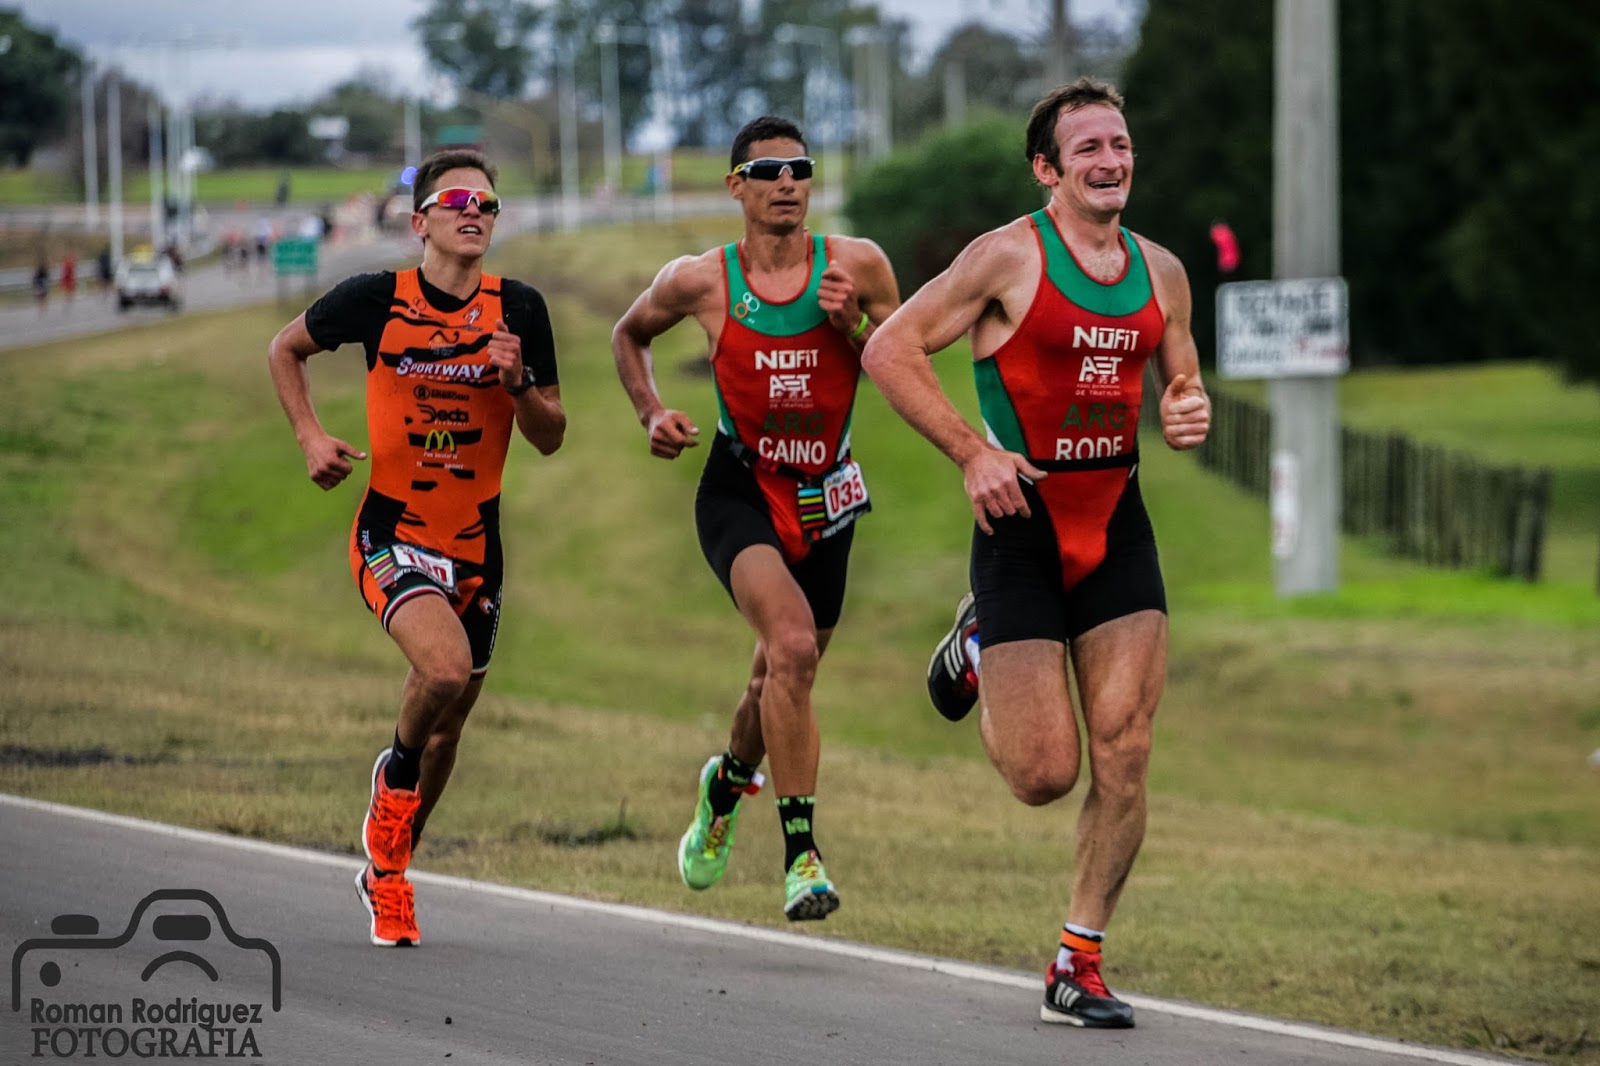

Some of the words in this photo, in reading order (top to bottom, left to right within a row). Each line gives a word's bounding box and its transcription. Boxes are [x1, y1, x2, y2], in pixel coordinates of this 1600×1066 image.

[763, 413, 824, 436] ARG
[1060, 402, 1127, 430] ARG
[758, 436, 827, 465] CAINO
[829, 473, 864, 514] 035
